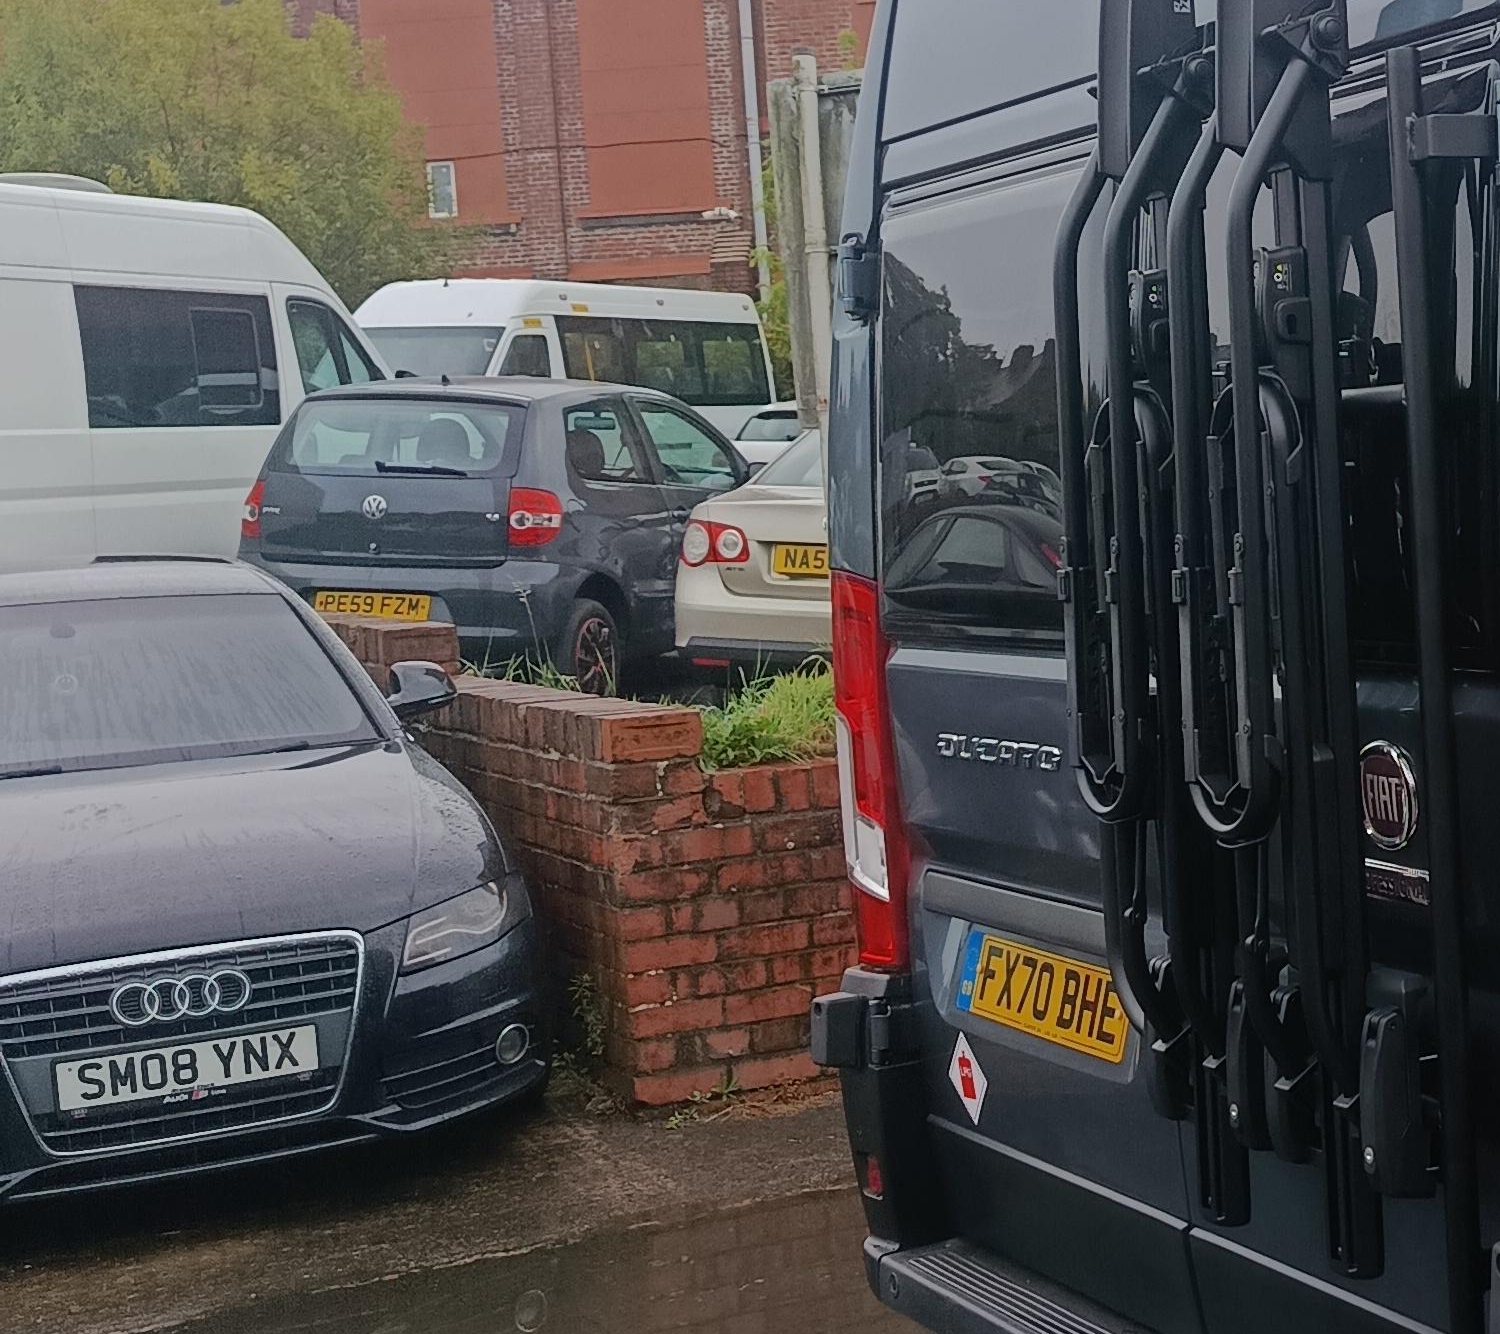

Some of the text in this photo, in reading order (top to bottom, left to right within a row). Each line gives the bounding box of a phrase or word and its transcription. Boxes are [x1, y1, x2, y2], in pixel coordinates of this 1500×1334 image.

[324, 594, 421, 616] PE59 FZM
[937, 733, 1062, 771] DUCATO
[1366, 773, 1402, 823] FIAT
[979, 944, 1117, 1046] FX70 BHE
[77, 1031, 300, 1100] SM08 YNX
